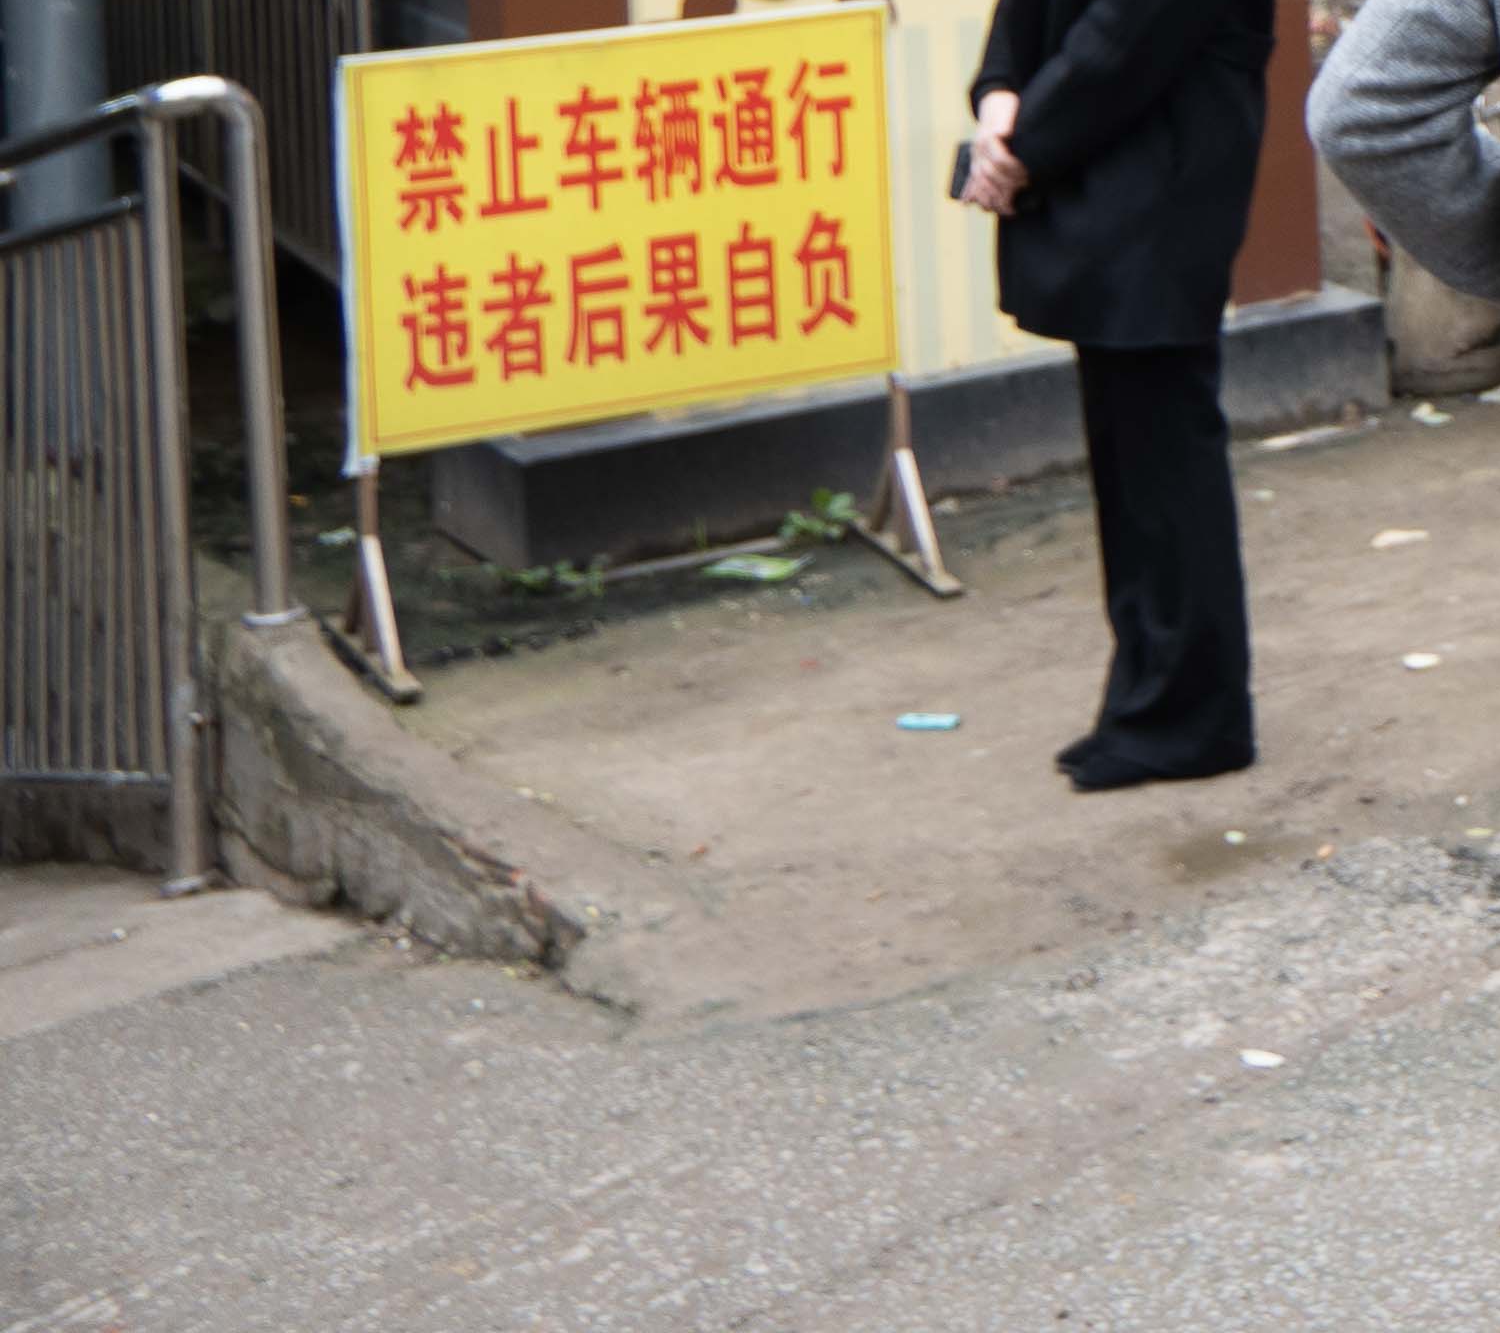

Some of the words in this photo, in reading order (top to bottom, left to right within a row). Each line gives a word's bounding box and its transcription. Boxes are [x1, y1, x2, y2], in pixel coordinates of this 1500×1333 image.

[392, 59, 854, 233] 禁止车辆通行
[401, 210, 858, 393] 违者后果自负
